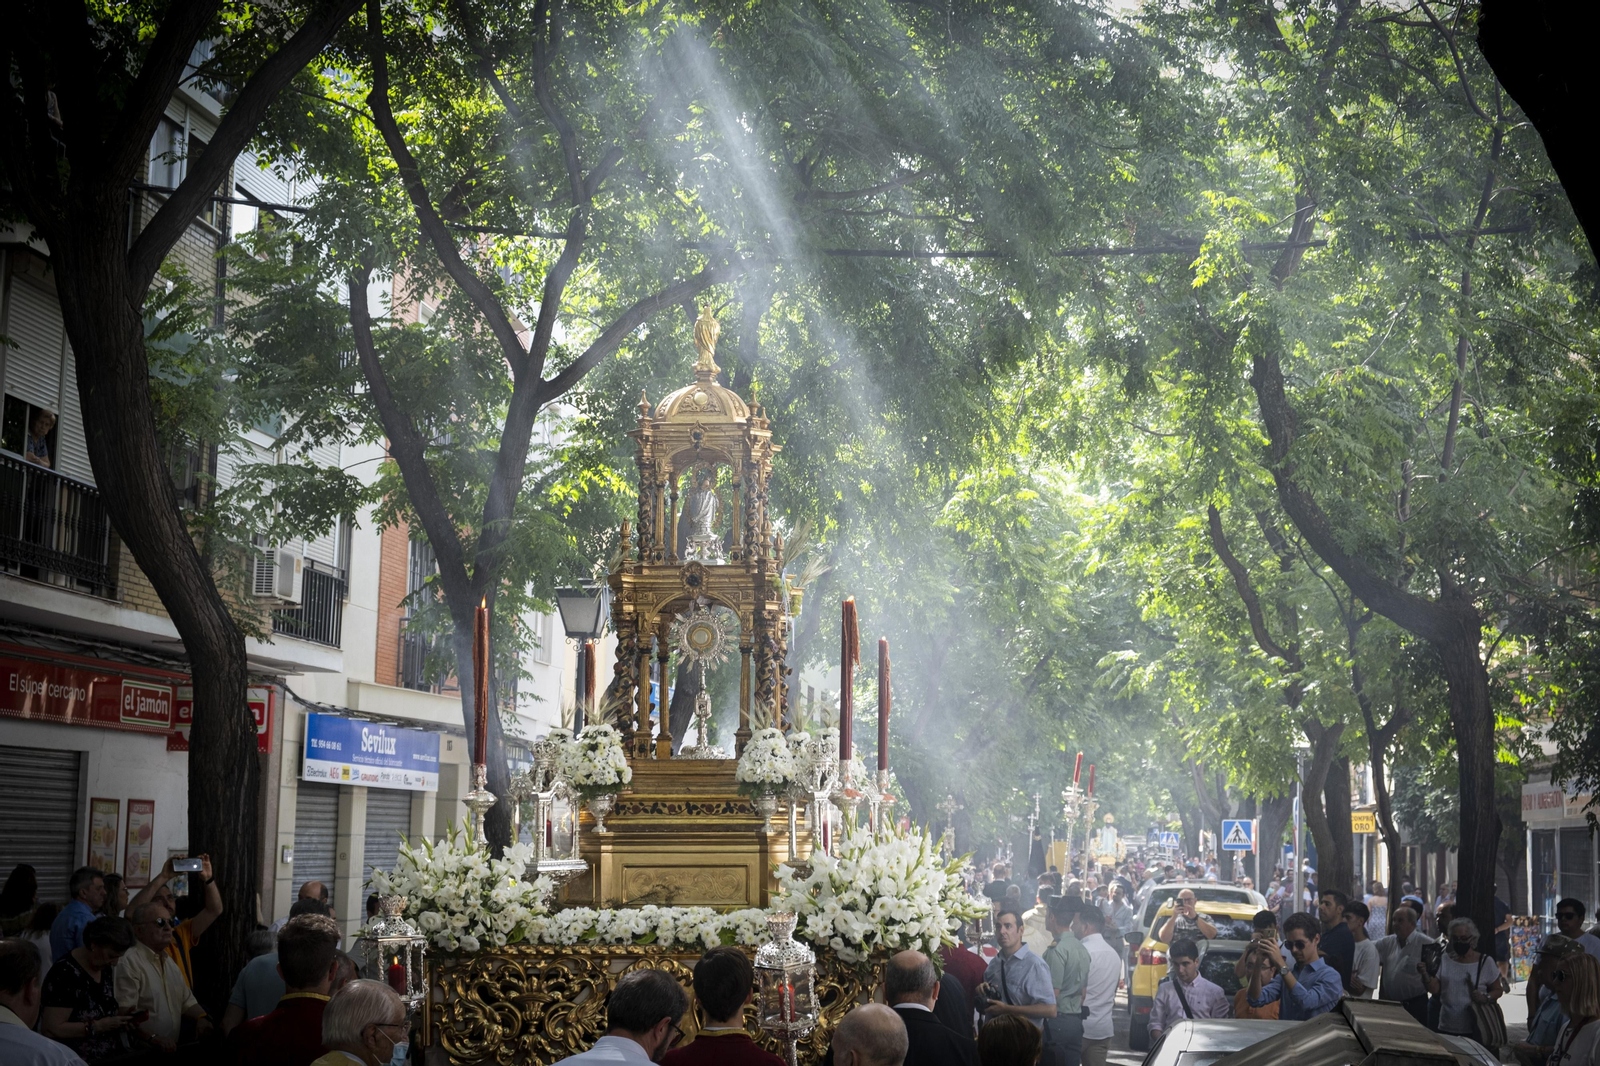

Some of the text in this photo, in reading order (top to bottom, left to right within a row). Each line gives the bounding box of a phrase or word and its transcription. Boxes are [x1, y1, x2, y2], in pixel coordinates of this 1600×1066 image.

[9, 673, 19, 692] El
[48, 682, 86, 702] cercano
[124, 688, 168, 716] el jamón
[361, 727, 397, 755] Sevilux
[330, 767, 340, 779] AEG
[1354, 823, 1370, 831] ORO
